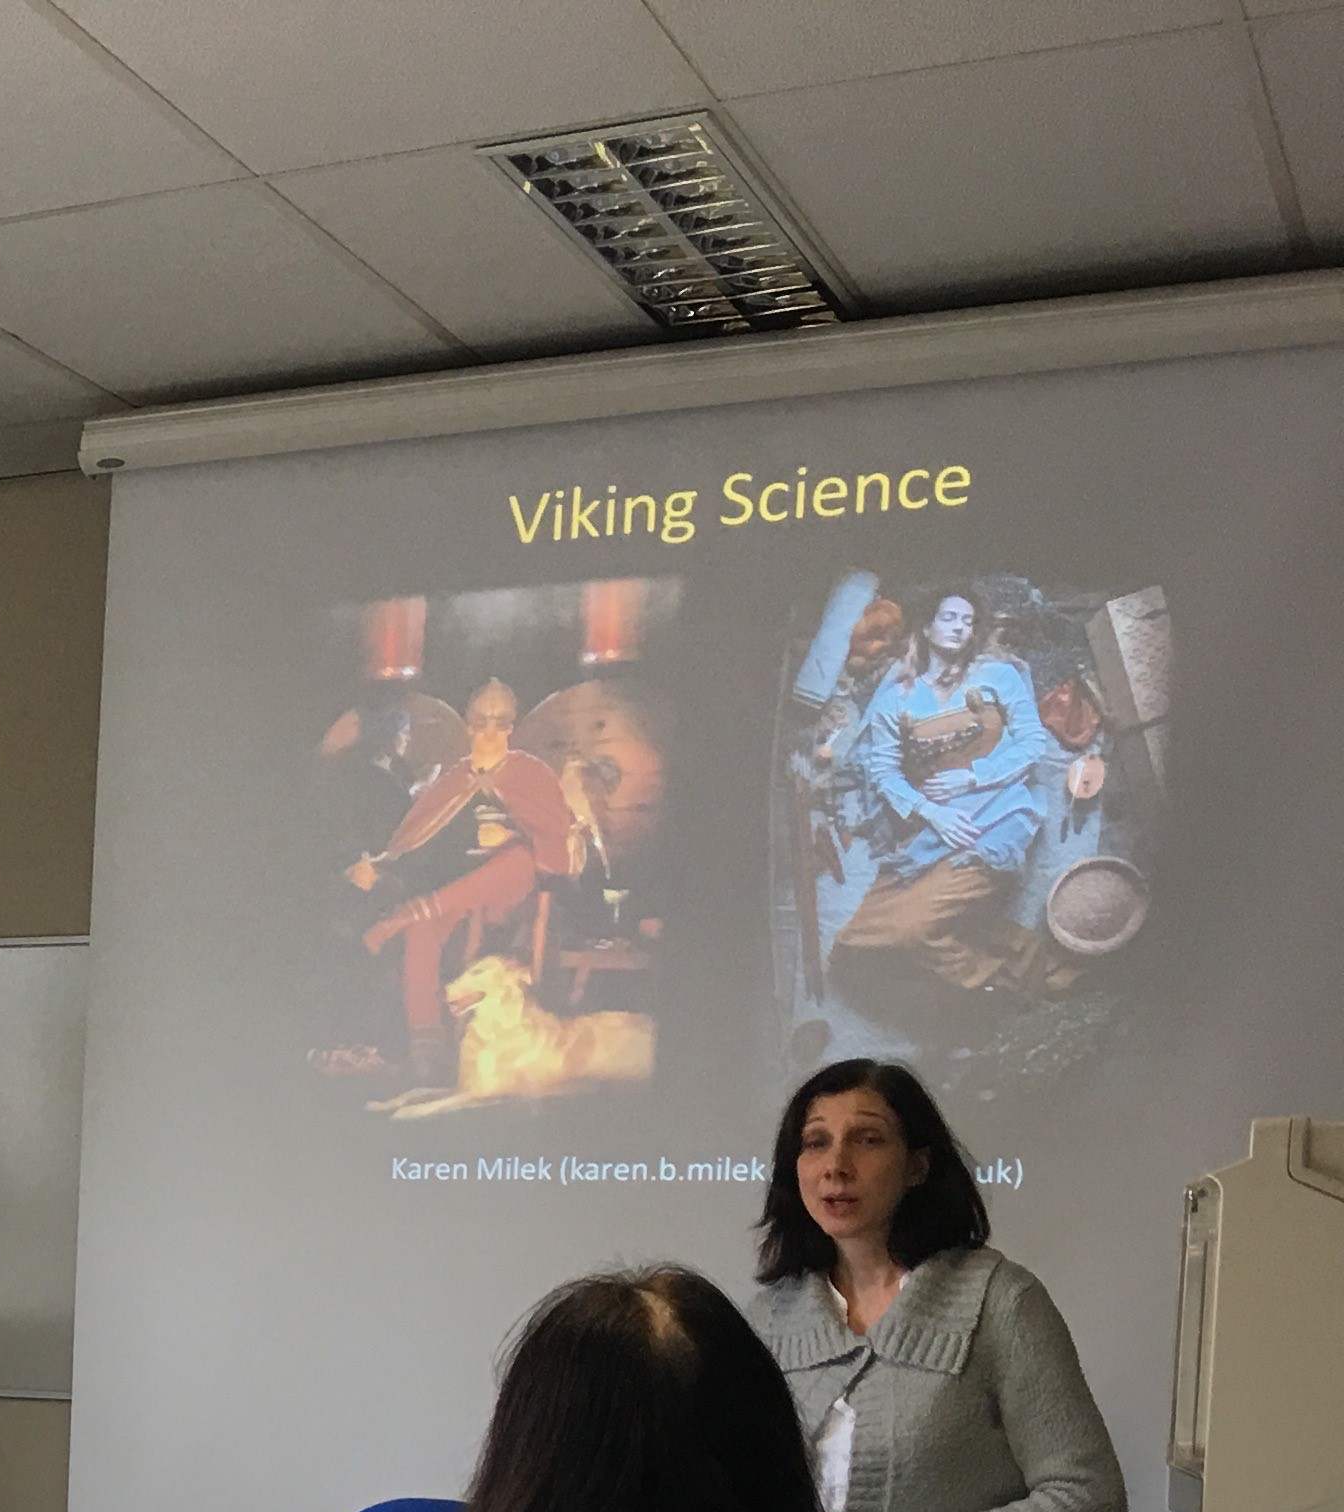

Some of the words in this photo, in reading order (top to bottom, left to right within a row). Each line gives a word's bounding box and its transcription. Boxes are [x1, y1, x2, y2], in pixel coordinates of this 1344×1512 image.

[509, 485, 698, 544] Viking
[720, 464, 972, 526] Science
[391, 1157, 468, 1181] Karen
[477, 1156, 552, 1181] Milek
[559, 1155, 766, 1186] (karen.b.milek
[975, 1157, 1024, 1190] uk)
